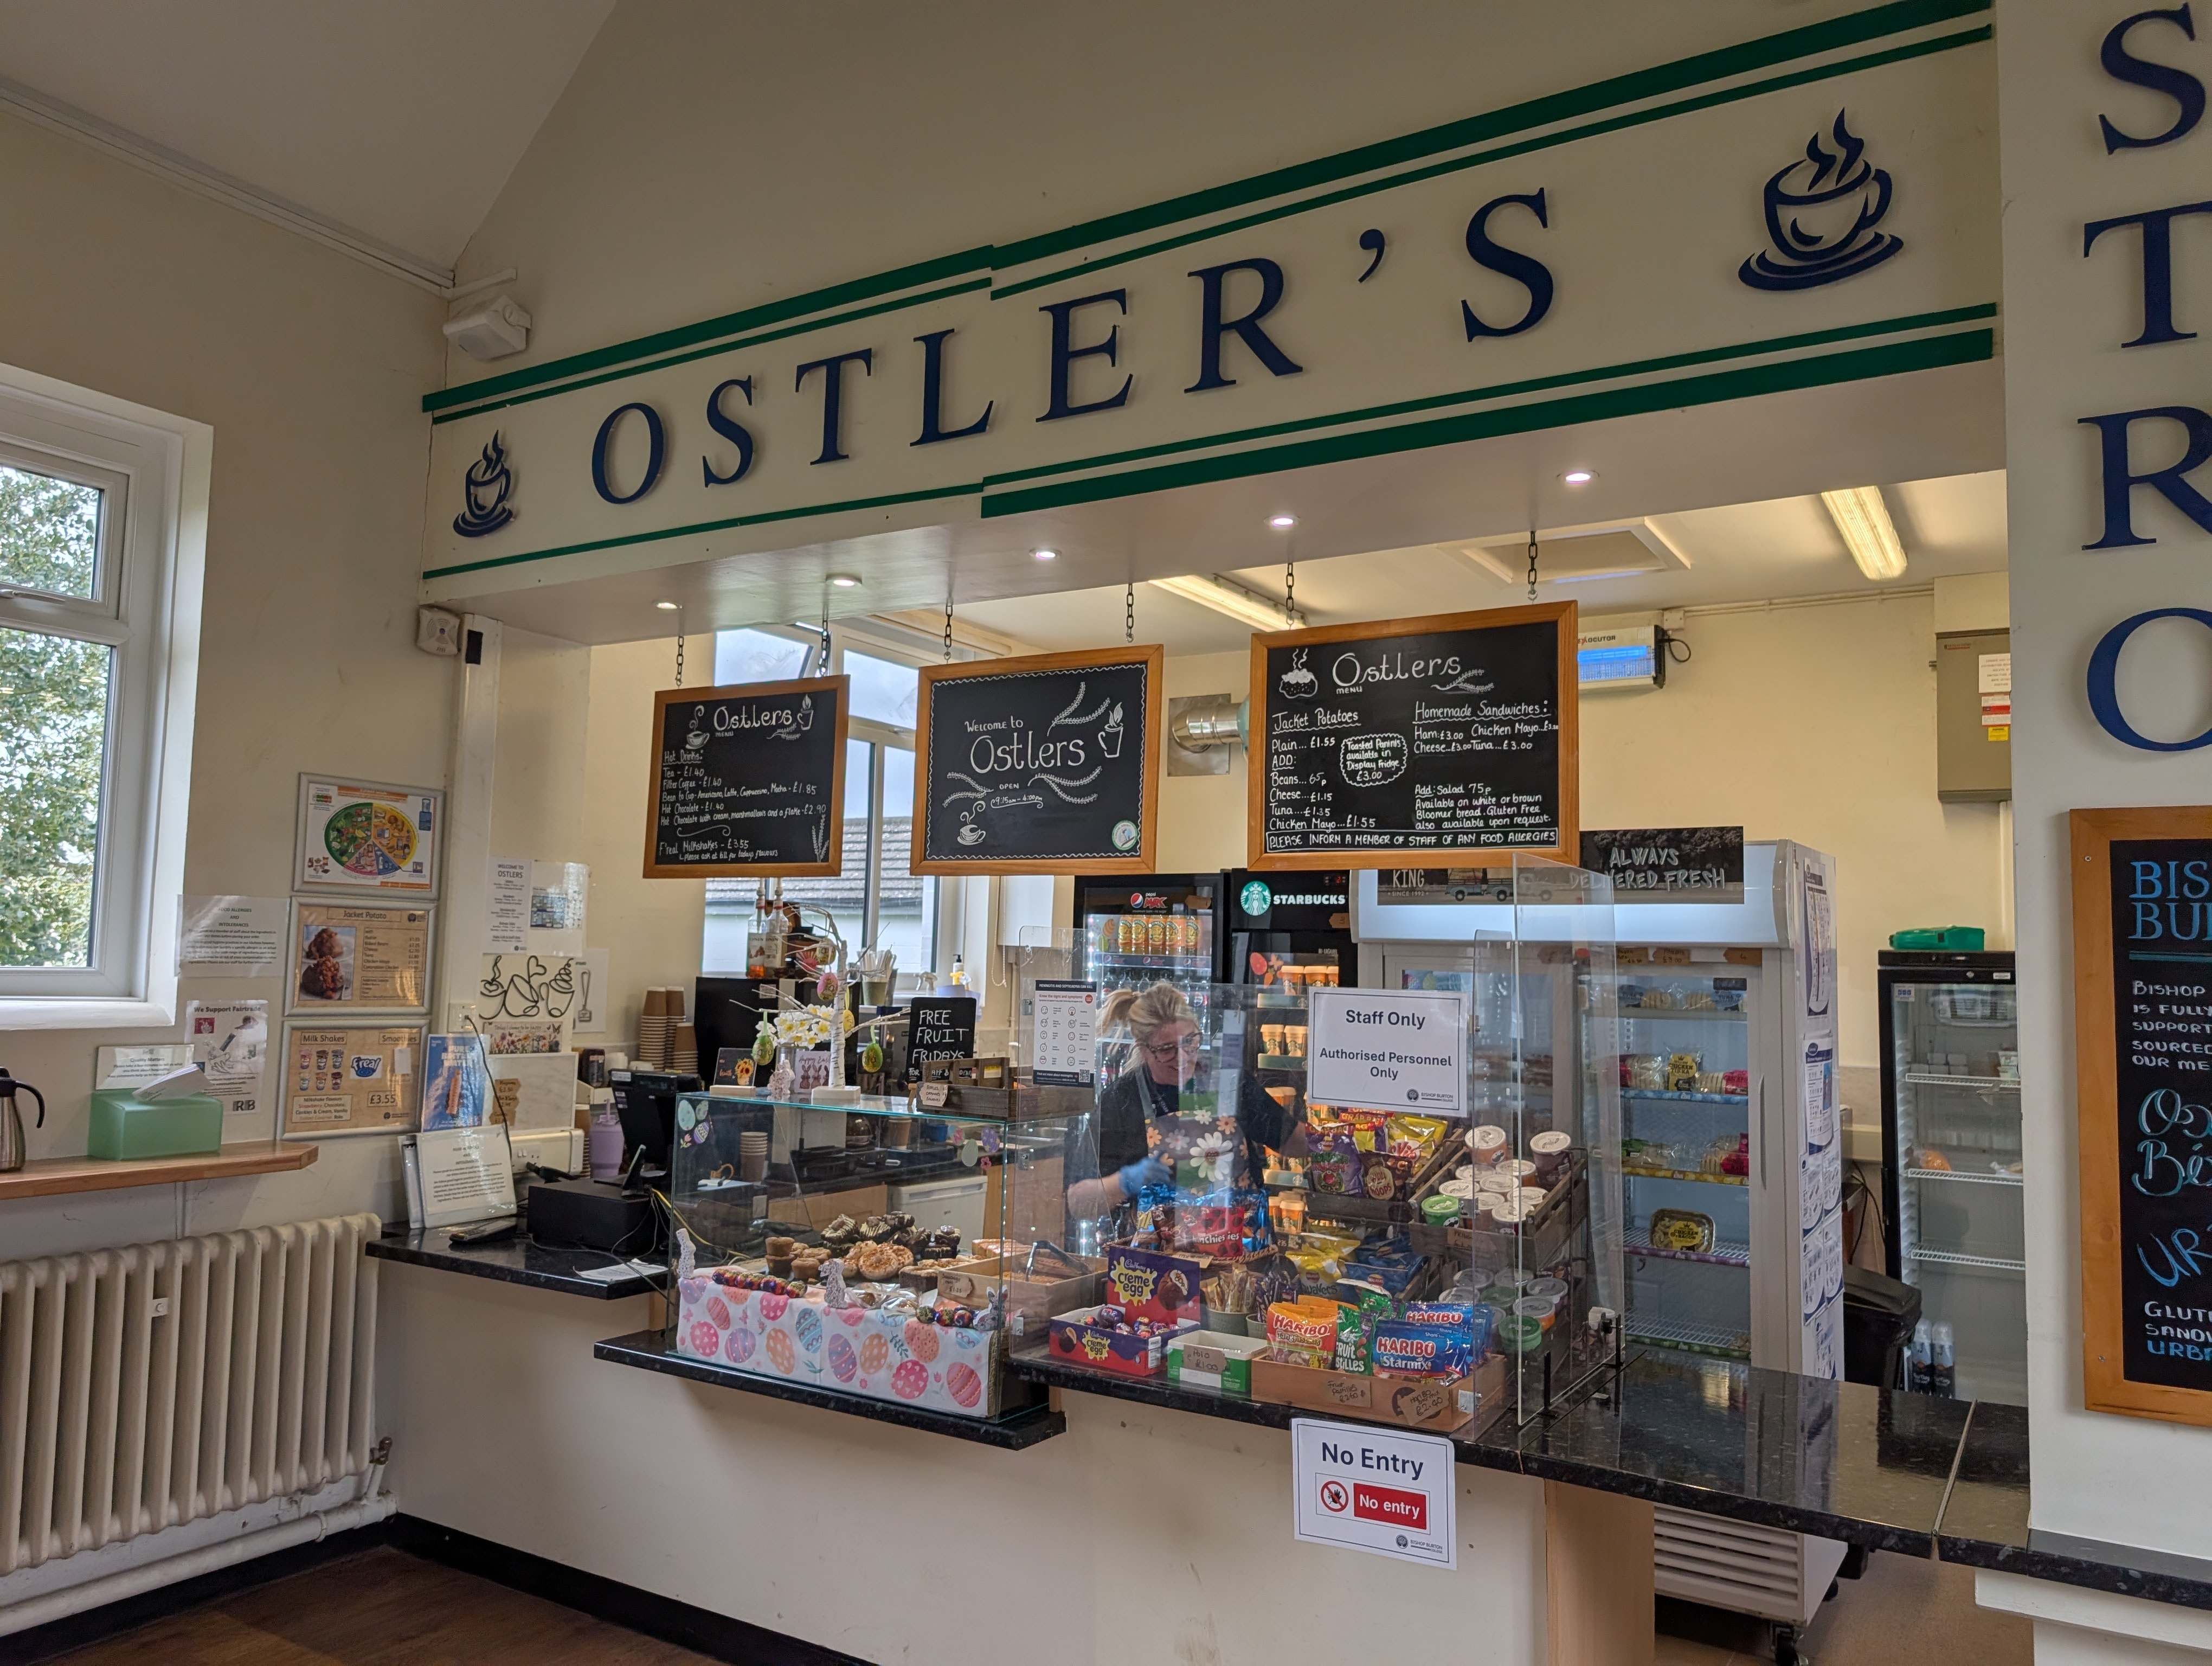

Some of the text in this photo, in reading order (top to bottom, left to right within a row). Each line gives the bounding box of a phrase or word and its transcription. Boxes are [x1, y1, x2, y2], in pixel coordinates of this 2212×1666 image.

[590, 185, 1556, 507] OSTLER'S
[1333, 652, 1461, 687] Ostlers
[1336, 686, 1362, 695] MENU
[713, 704, 793, 731] Ostlers
[1415, 701, 1471, 721] Homemade
[1011, 715, 1023, 728] to
[1272, 708, 1358, 731] Jacket Potatoes
[1441, 731, 1463, 740] £3.00
[1471, 723, 1511, 737] Chicken
[1310, 736, 1335, 748] £1.55
[1346, 740, 1373, 751] Toasted
[1451, 742, 1471, 752] £3.00
[665, 751, 676, 762] Hot
[970, 731, 1085, 773] Ostlers
[1346, 749, 1391, 760] available in
[663, 766, 704, 778] Tea £1.40
[1346, 760, 1400, 771] Display Fridge
[1356, 771, 1382, 781] £3.00
[663, 776, 722, 791] Filter Coffee £1.40
[1437, 784, 1464, 794] Salad
[1468, 783, 1491, 794] 75p
[663, 792, 676, 802] Bean
[679, 791, 684, 800] to
[771, 783, 786, 793] Mocha
[793, 781, 817, 794] £1.85
[1310, 792, 1333, 802] £1.15
[662, 801, 724, 814] Hot Chocolate £1.40
[1415, 799, 1455, 810] Available
[1472, 796, 1496, 805] white
[1512, 793, 1542, 803] brown
[661, 816, 670, 825] Hot
[674, 815, 697, 825] Chocolate
[700, 814, 711, 822] with
[731, 809, 766, 821] marshmallows
[768, 809, 778, 817] and
[783, 808, 800, 818] flake
[805, 804, 826, 814] £2.90
[1416, 804, 1540, 819] Bloomer Gluten Free
[1269, 815, 1376, 830] Chicken £1.55
[1415, 820, 1435, 830] also
[1442, 818, 1484, 828] available
[1489, 818, 1510, 828] upon
[683, 840, 718, 852] Milkshakes
[728, 839, 749, 849] £3.55
[1270, 832, 1555, 849] PLEASE INFORM A MEMBER OF STAFF OF ANY FOOD ALLERGIES
[738, 849, 754, 861] todays
[755, 849, 778, 859] flavours
[1609, 847, 1679, 868] ALWAYS
[1393, 869, 1425, 888] KING
[1664, 868, 1725, 892] FRESH
[1273, 895, 1346, 905] STARBUCKS
[2133, 1004, 2150, 1014] IS
[919, 1009, 951, 1026] FREE
[1346, 1009, 1425, 1030] Staff Only
[916, 1027, 969, 1045] FRUIT
[912, 1048, 965, 1065] FRIDAYS
[1320, 1048, 1452, 1066] Authorised Personnel
[2132, 1055, 2169, 1067] OUR
[909, 1067, 920, 1075] FOR
[1370, 1067, 1398, 1081] Only
[370, 1094, 396, 1104] £3.55
[1123, 1283, 1143, 1297] egg
[1274, 1313, 1329, 1336] HARIBO
[1406, 1311, 1463, 1324] HARIBO
[1090, 1346, 1103, 1355] egg
[1377, 1337, 1436, 1357] HARIBO
[1382, 1356, 1430, 1370] Starmix
[1322, 1442, 1424, 1481] No Entry
[1360, 1494, 1419, 1520] No entry
[1426, 1542, 1443, 1550] BURTON
